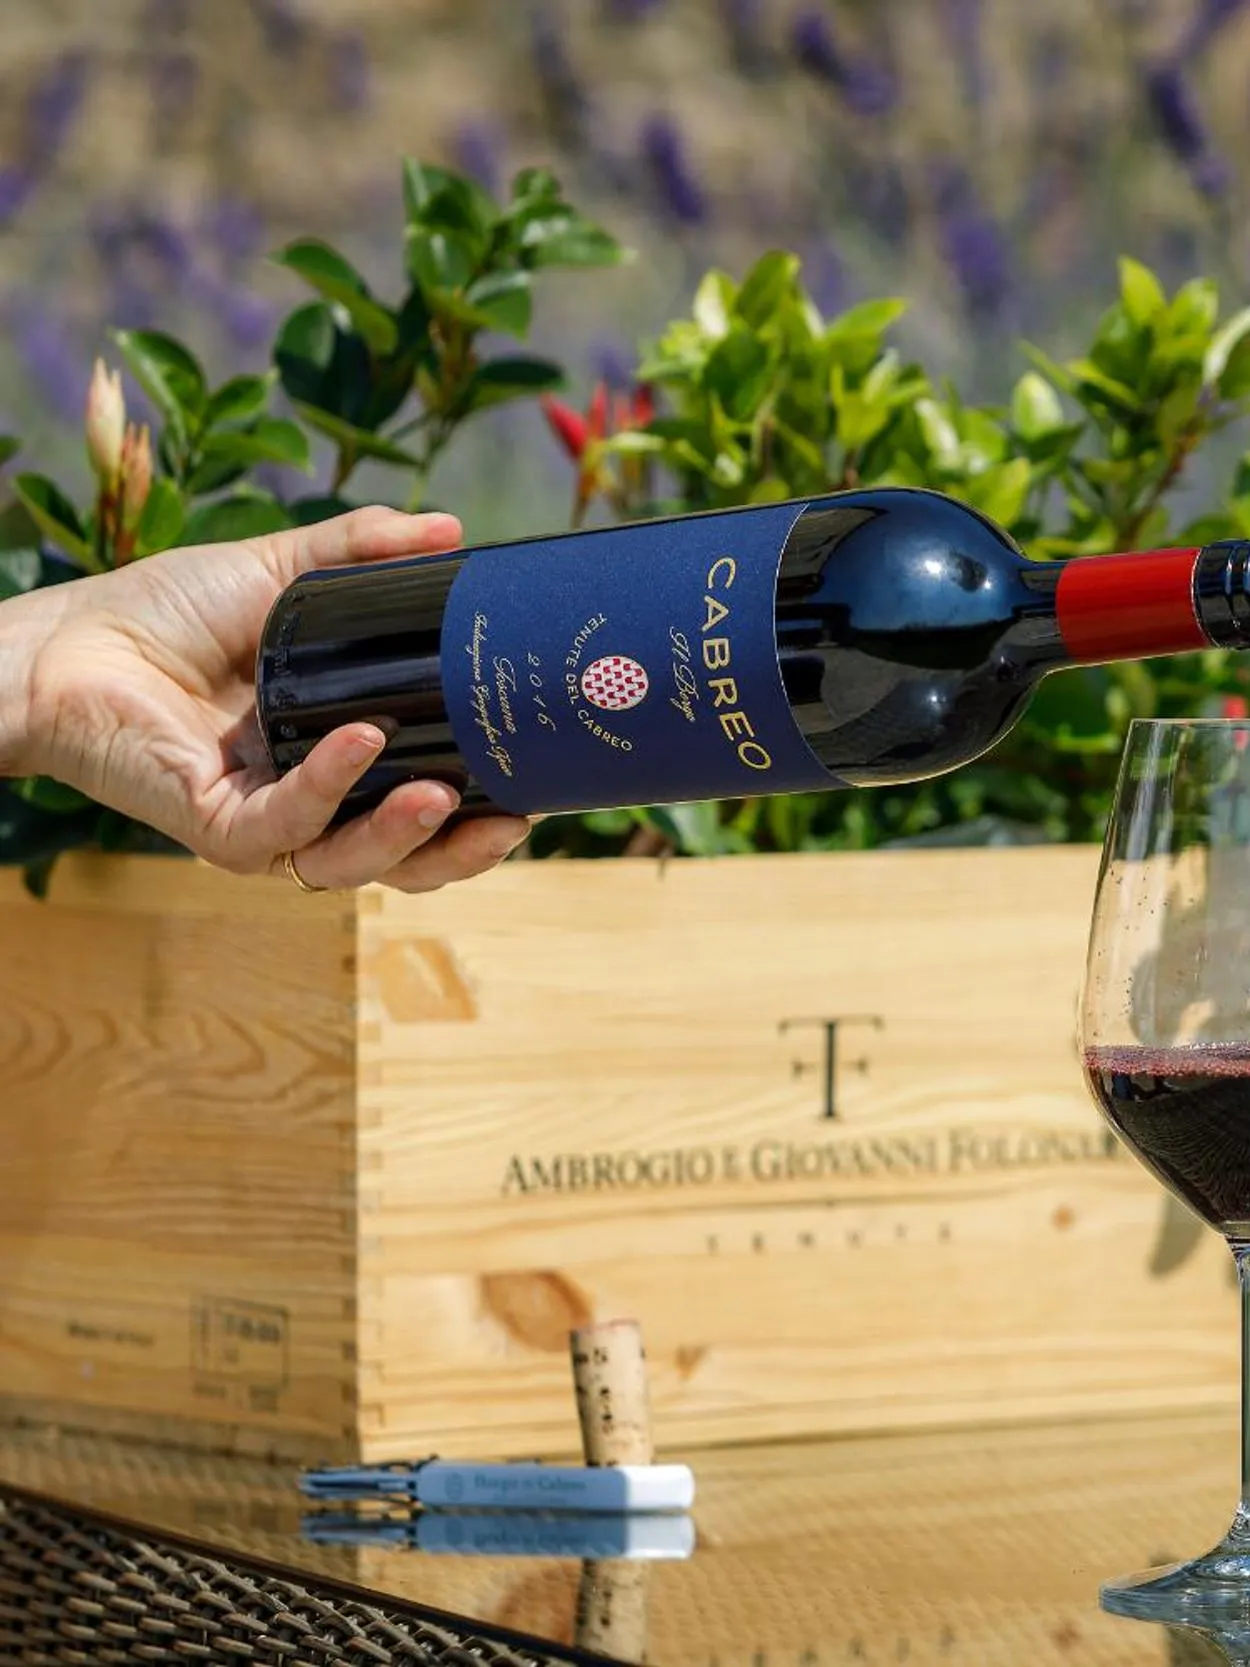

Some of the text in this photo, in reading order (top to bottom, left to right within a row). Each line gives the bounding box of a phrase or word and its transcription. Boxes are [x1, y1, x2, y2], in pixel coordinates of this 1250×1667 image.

[492, 655, 518, 735] Toscana
[565, 612, 634, 752] TENUTE DEL CABREO
[669, 662, 700, 723] Borgo
[702, 557, 772, 770] CABREO
[502, 1145, 715, 1196] AMBROGIO
[749, 1133, 940, 1184] GIOVANNI
